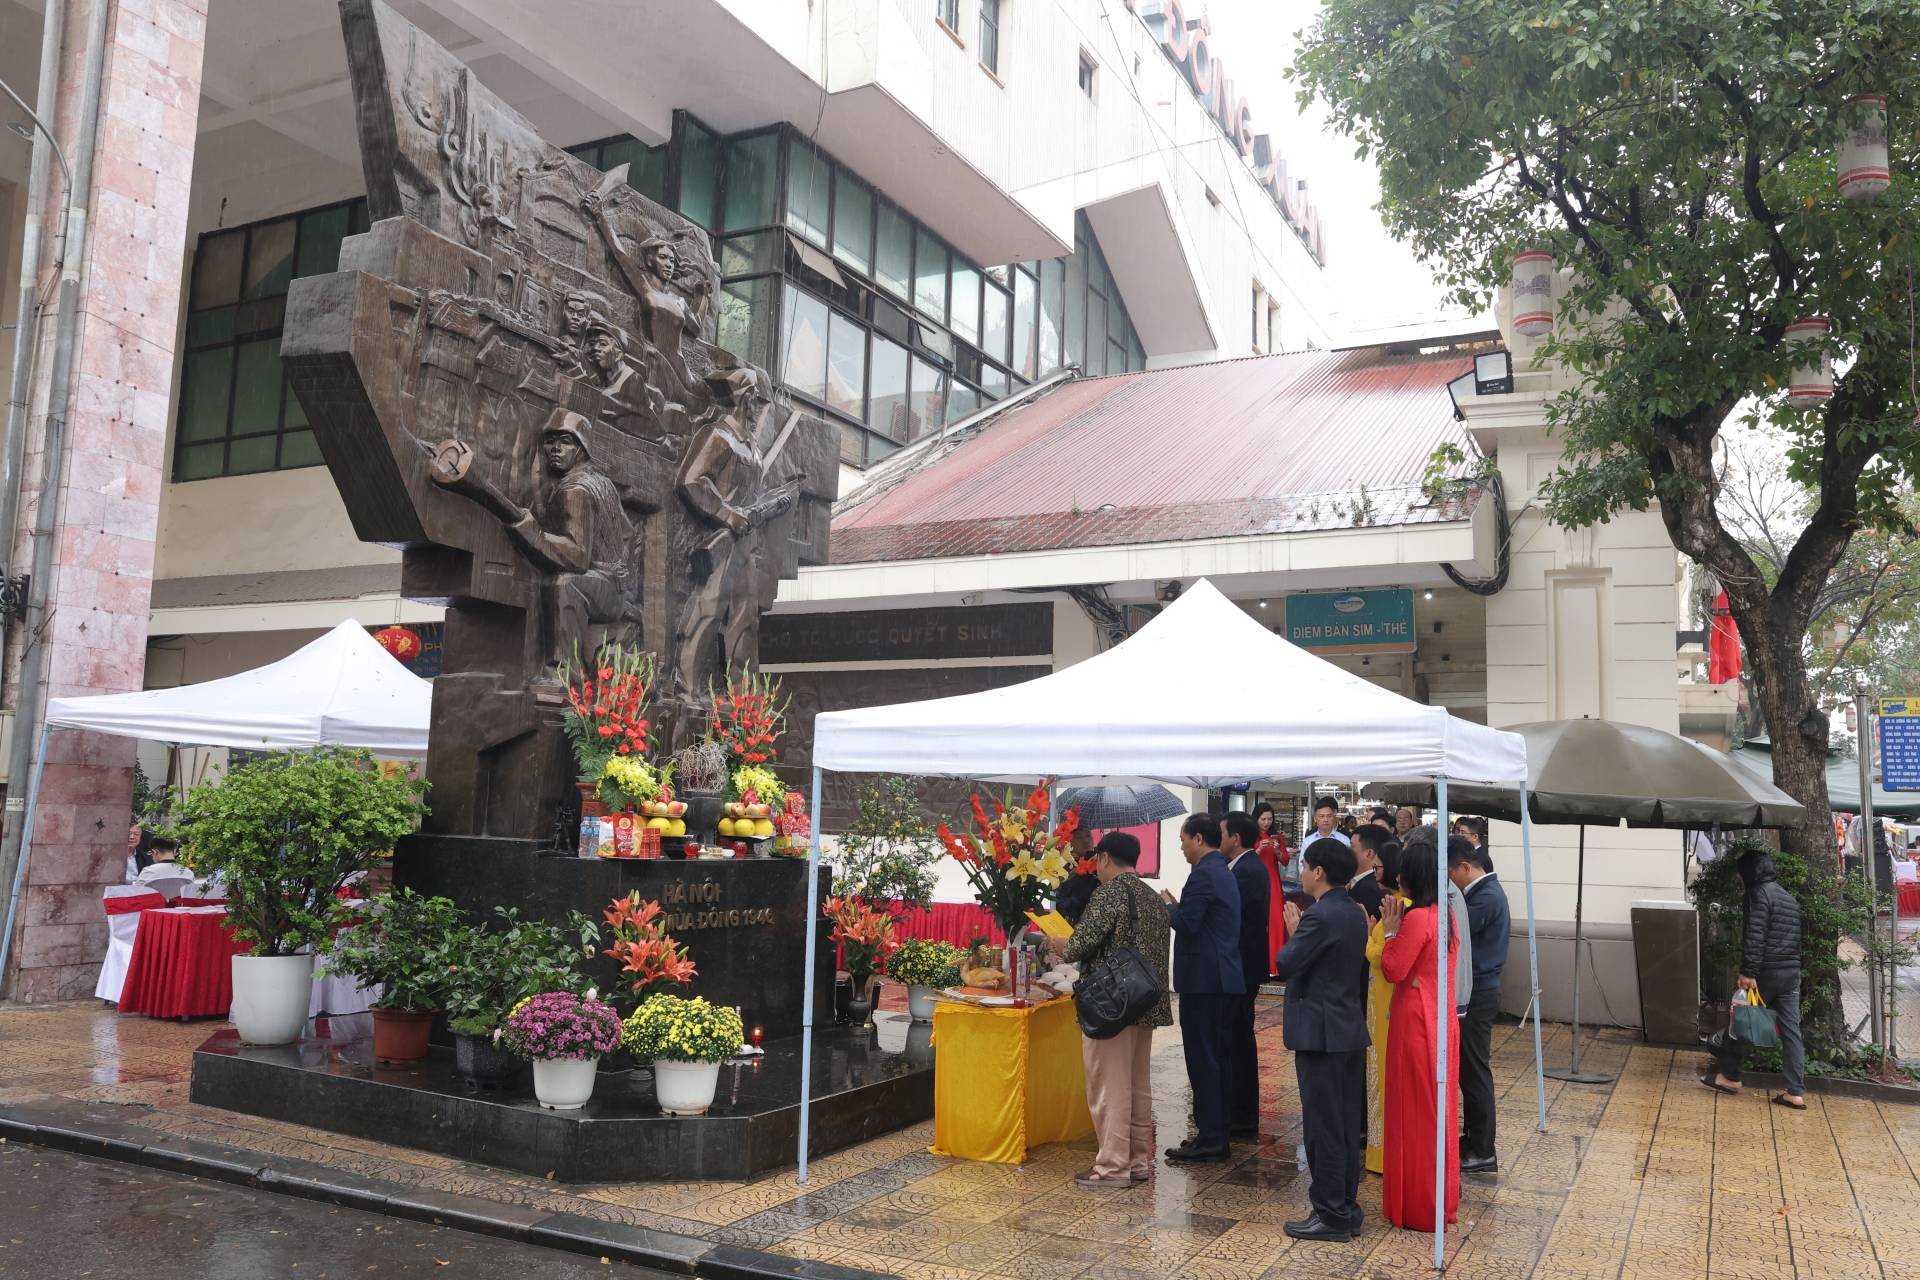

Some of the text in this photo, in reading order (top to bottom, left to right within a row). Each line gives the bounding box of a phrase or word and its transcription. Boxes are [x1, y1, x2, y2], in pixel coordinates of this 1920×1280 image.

[1252, 133, 1327, 267] XUÂN
[957, 624, 1002, 642] SINH
[1324, 621, 1349, 638] BÁN
[1353, 623, 1373, 637] SIM
[1383, 618, 1408, 635] THẺ
[661, 876, 722, 908] HÀ NỘI
[662, 906, 775, 932] MÙA ĐÔNG 1946
